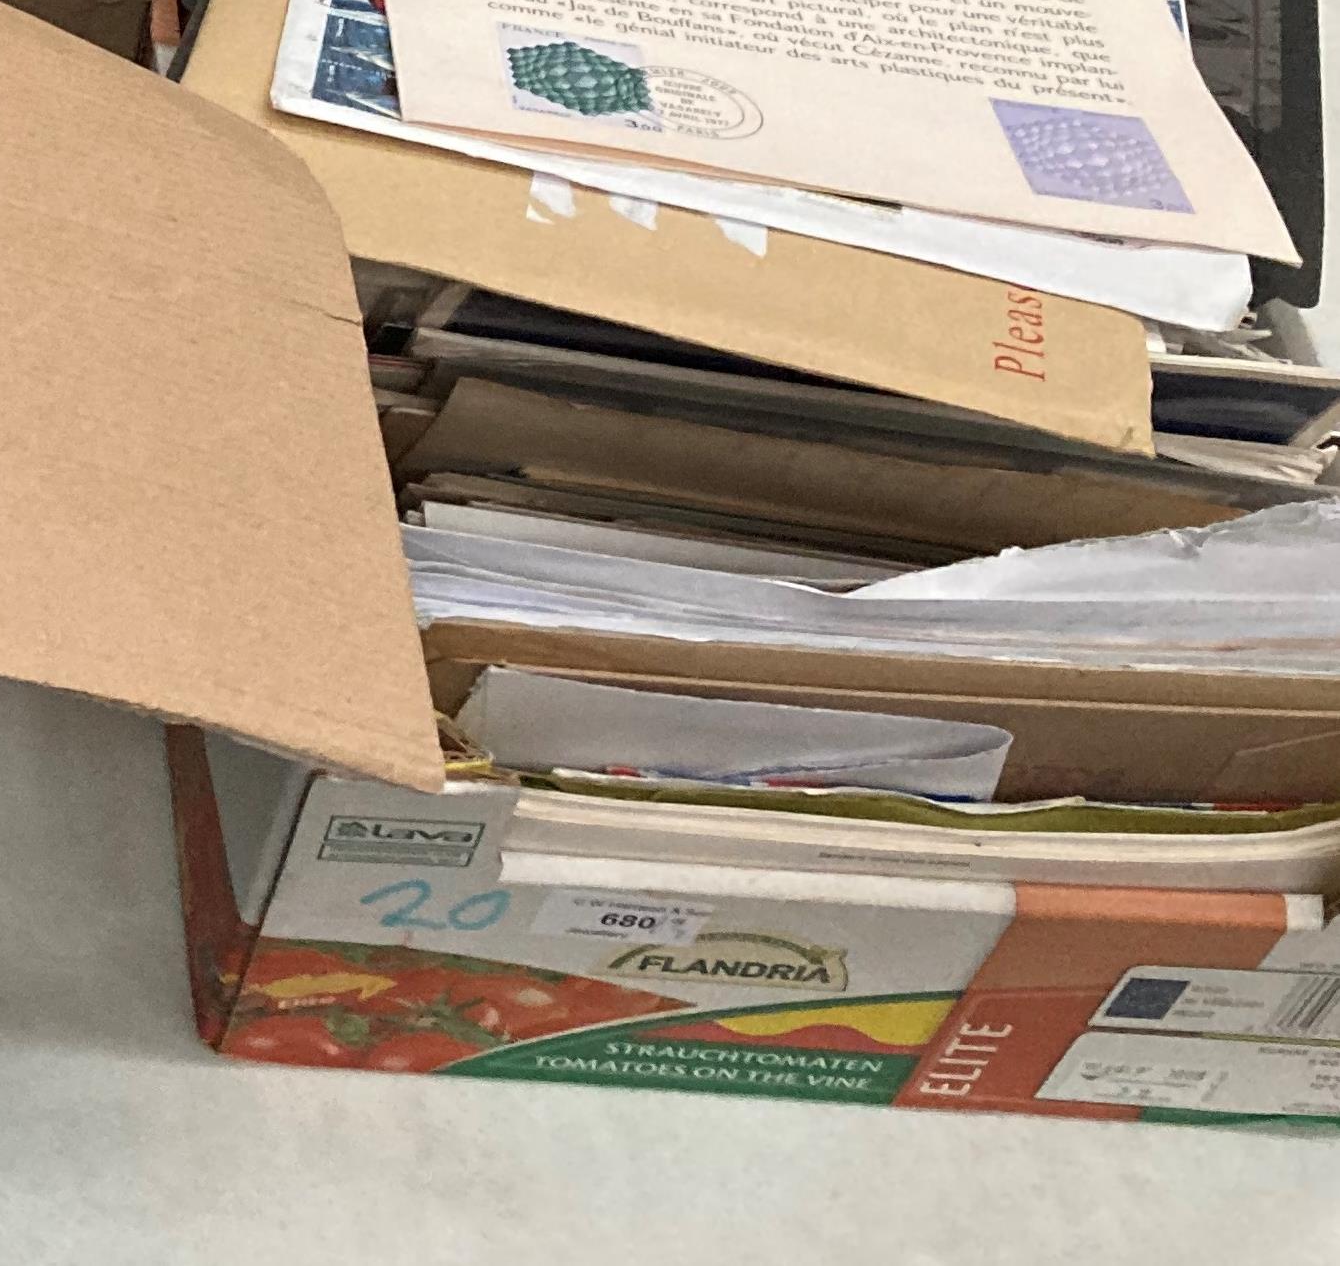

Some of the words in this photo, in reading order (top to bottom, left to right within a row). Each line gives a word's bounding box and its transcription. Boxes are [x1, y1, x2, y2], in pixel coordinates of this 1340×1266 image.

[992, 291, 1046, 382] Pleas
[360, 878, 512, 931] 20
[600, 912, 656, 930] 680
[637, 955, 832, 985] FLANDRIA
[536, 1055, 688, 1078] TOMATOES
[693, 1066, 739, 1080] ON
[747, 1070, 800, 1085] THE
[807, 1074, 873, 1090] VINE
[604, 1042, 885, 1073] STRAUCHTOMATEN
[920, 1021, 1015, 1099] ELITE
